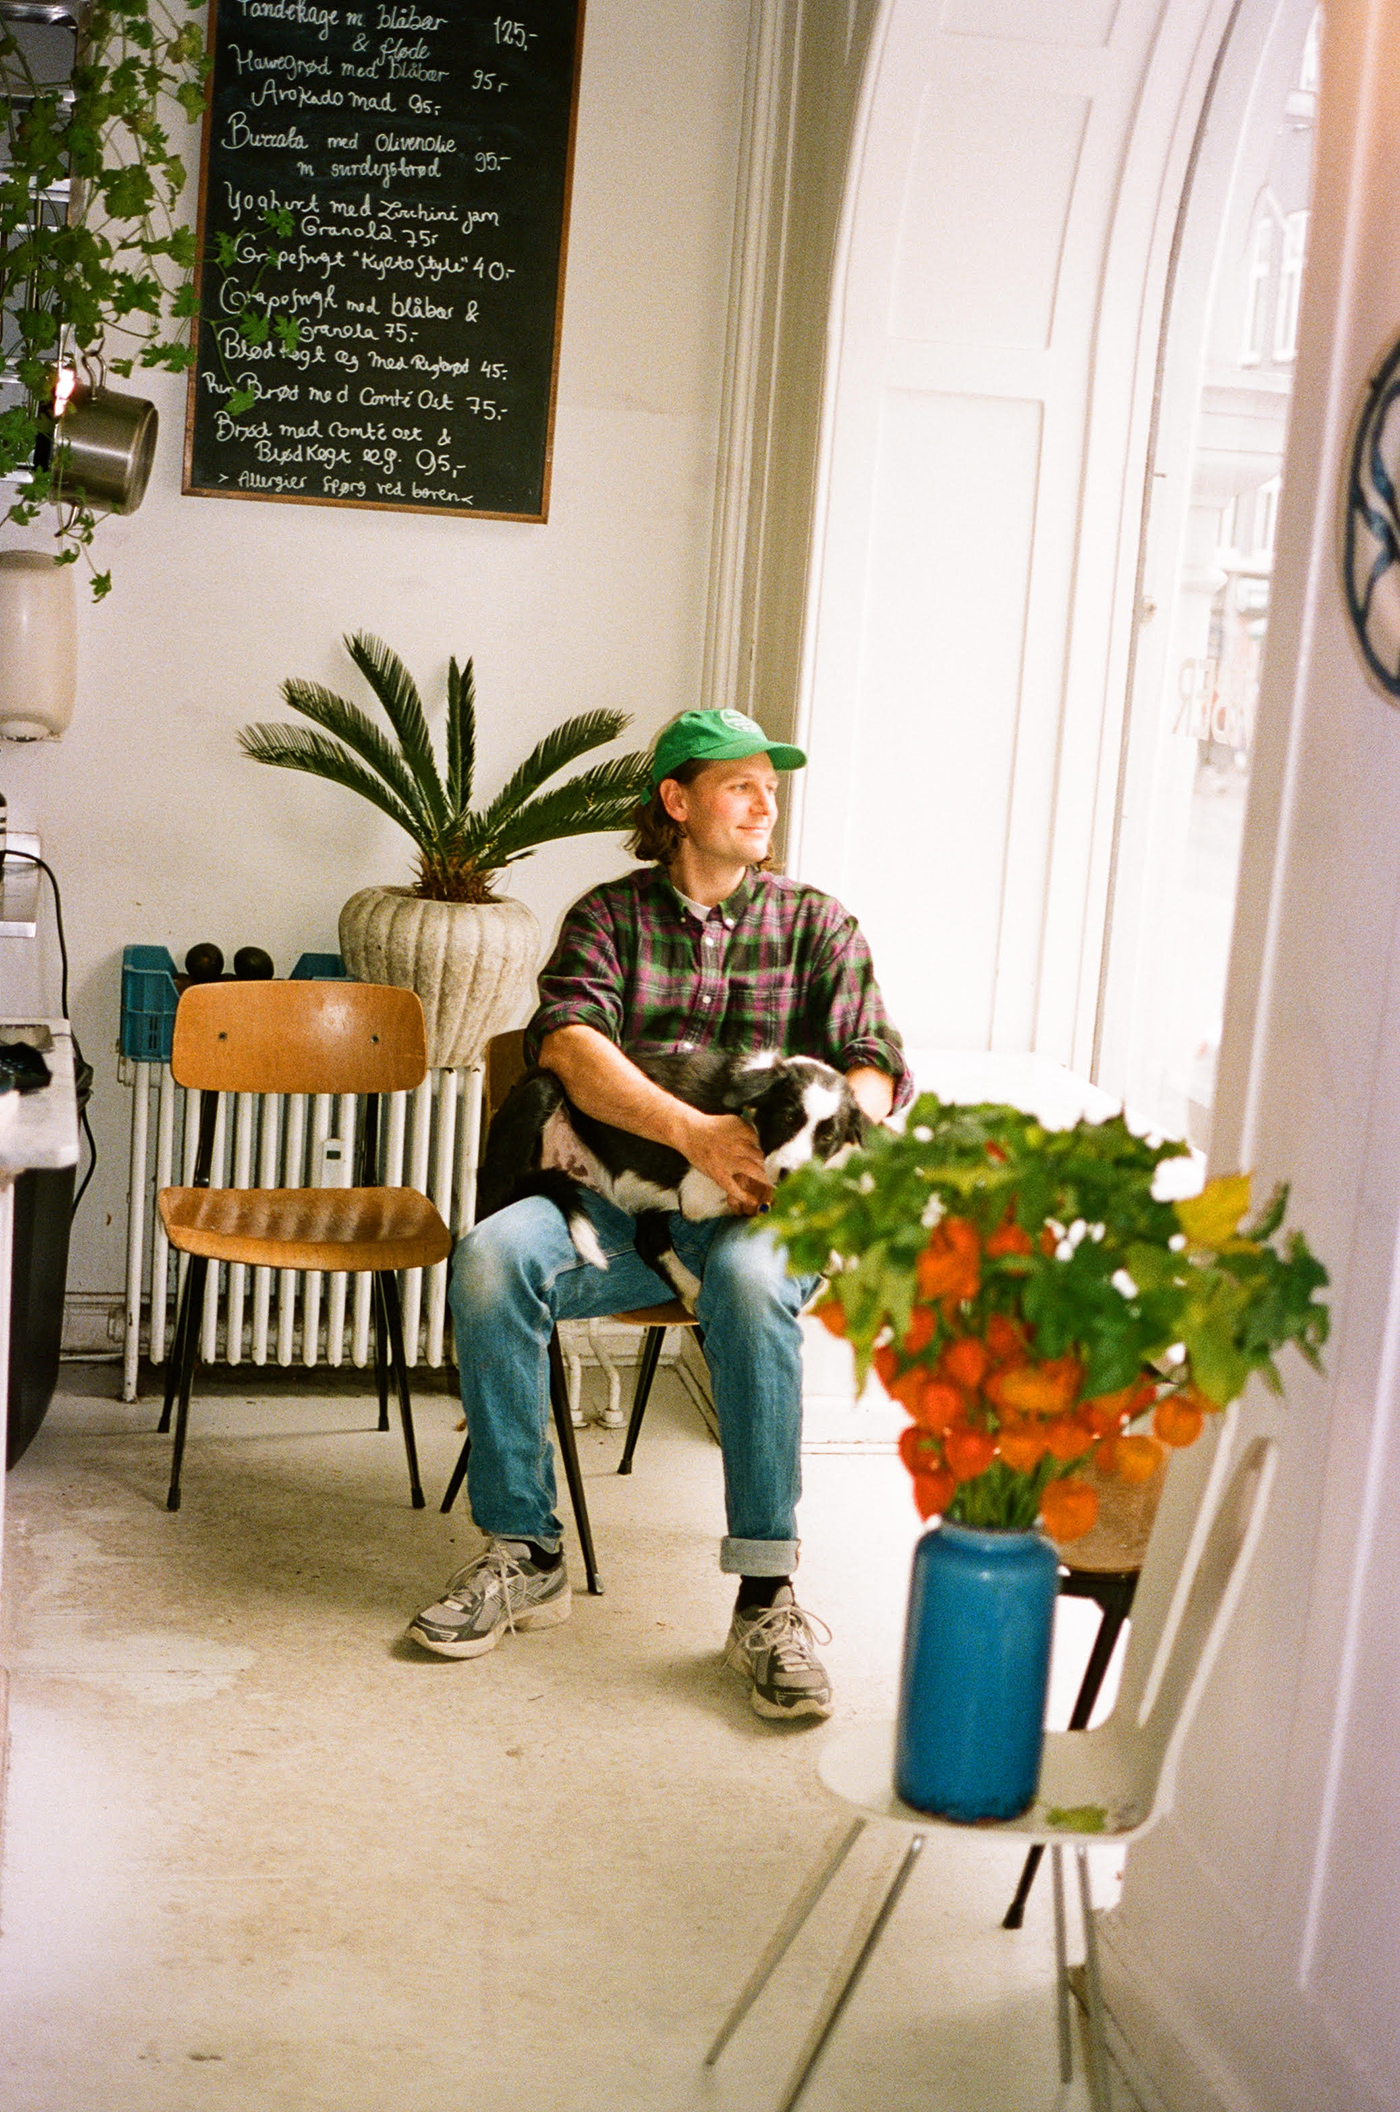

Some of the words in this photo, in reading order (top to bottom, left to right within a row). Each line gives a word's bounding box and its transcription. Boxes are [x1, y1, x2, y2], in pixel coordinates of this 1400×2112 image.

[376, 4, 448, 30] blåbær
[353, 33, 370, 52] &
[375, 37, 430, 66] fløde
[341, 60, 379, 79] med
[389, 55, 450, 82] blåbær
[348, 92, 396, 112] mad
[221, 111, 308, 149] Burrata
[327, 132, 358, 149] med
[223, 181, 320, 221] Yoghurt
[330, 193, 372, 217] med
[462, 210, 499, 234] jam
[234, 233, 346, 279] Grpefrugt
[347, 296, 381, 315] med
[391, 292, 454, 320] blåbær
[465, 300, 480, 323] &
[297, 317, 380, 343] Granola
[309, 384, 348, 403] med
[360, 387, 413, 408] Comté
[214, 410, 272, 442] Brød
[279, 420, 323, 438] med
[392, 427, 422, 441] ost
[437, 428, 451, 446] &
